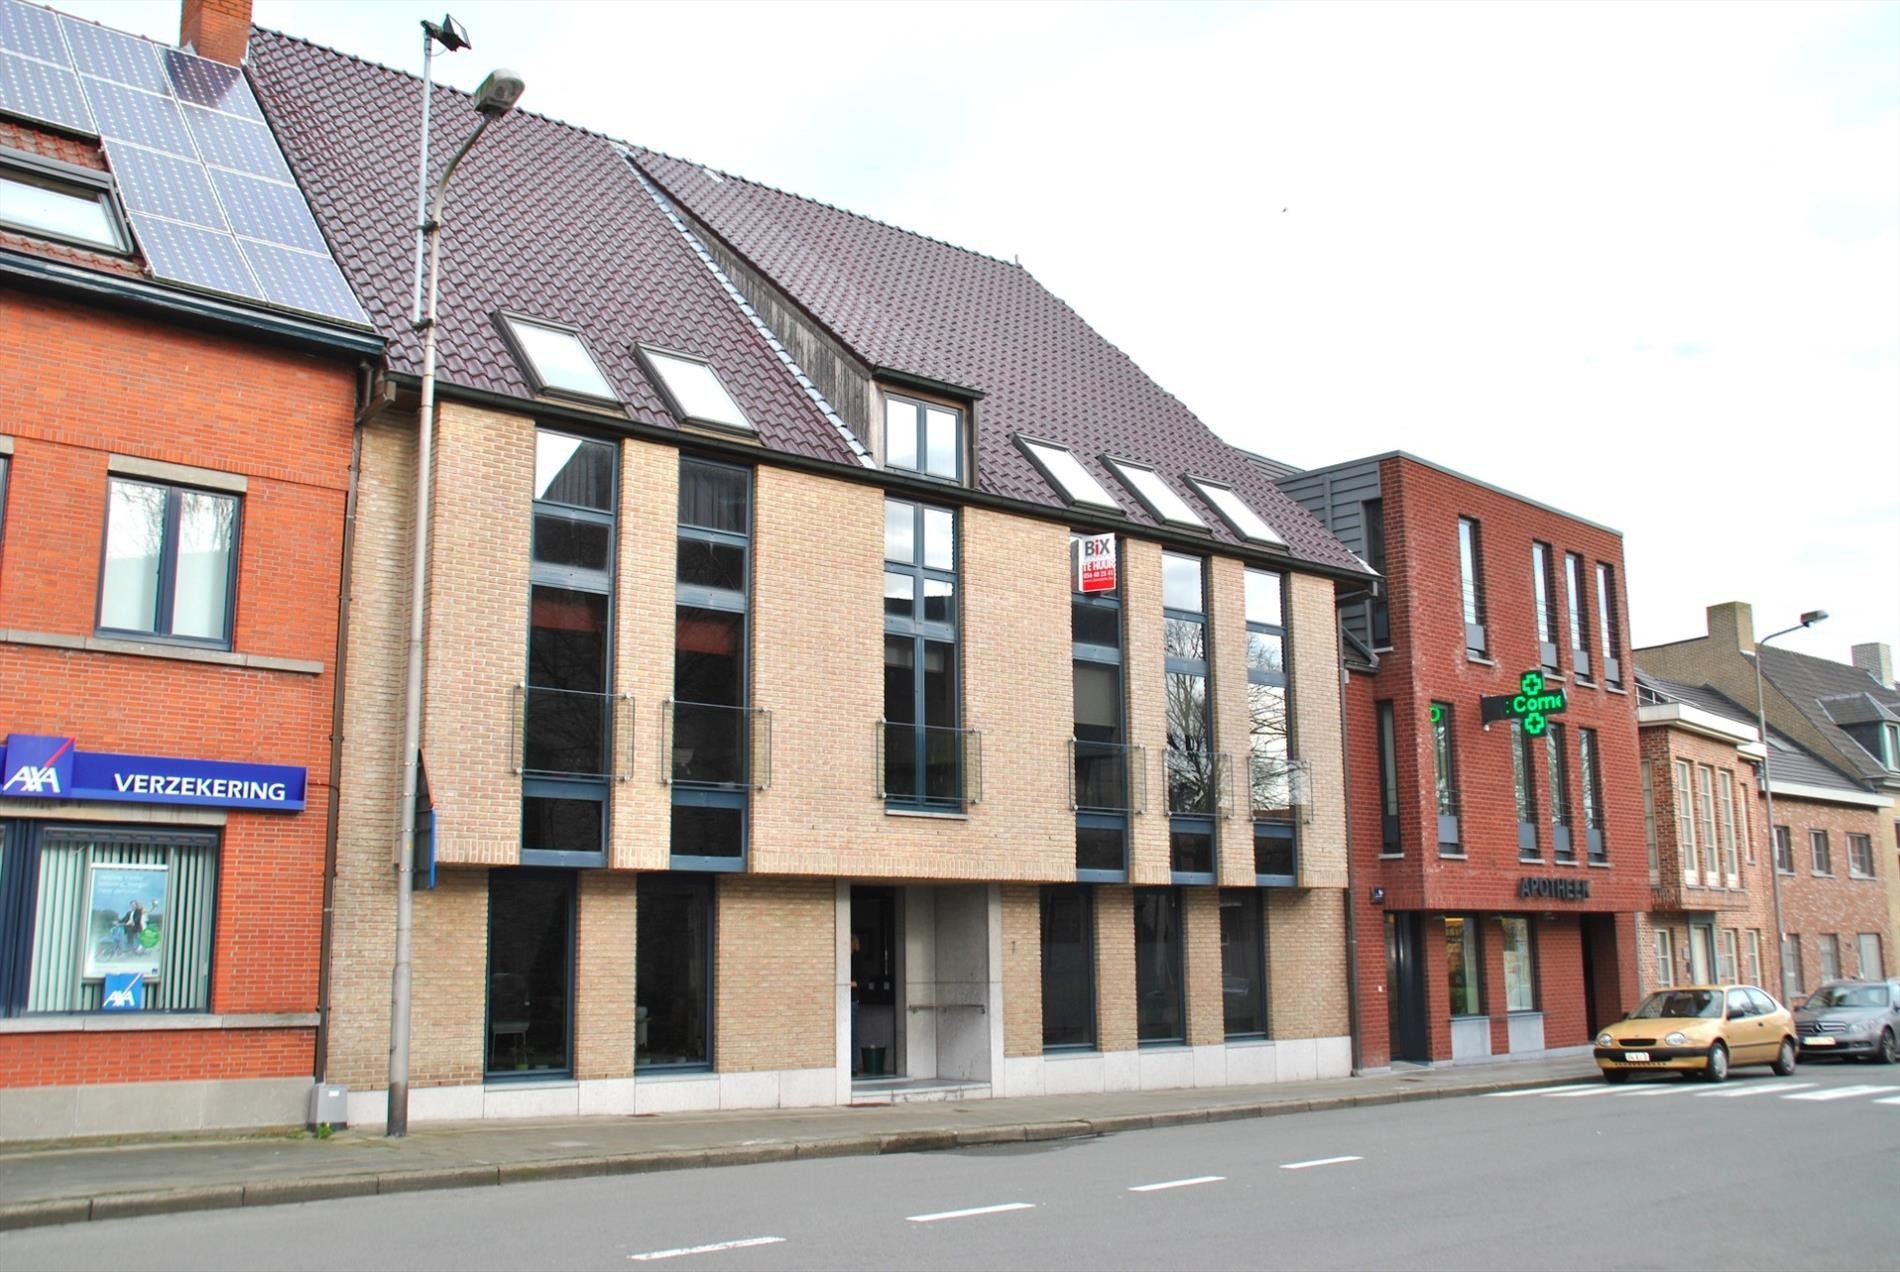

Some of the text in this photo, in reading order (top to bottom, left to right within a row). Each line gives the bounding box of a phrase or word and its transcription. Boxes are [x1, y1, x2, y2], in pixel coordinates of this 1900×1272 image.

[1085, 538, 1110, 556] BiX
[2, 765, 286, 801] AXA VERZEKERING
[103, 990, 135, 1007] AXA
